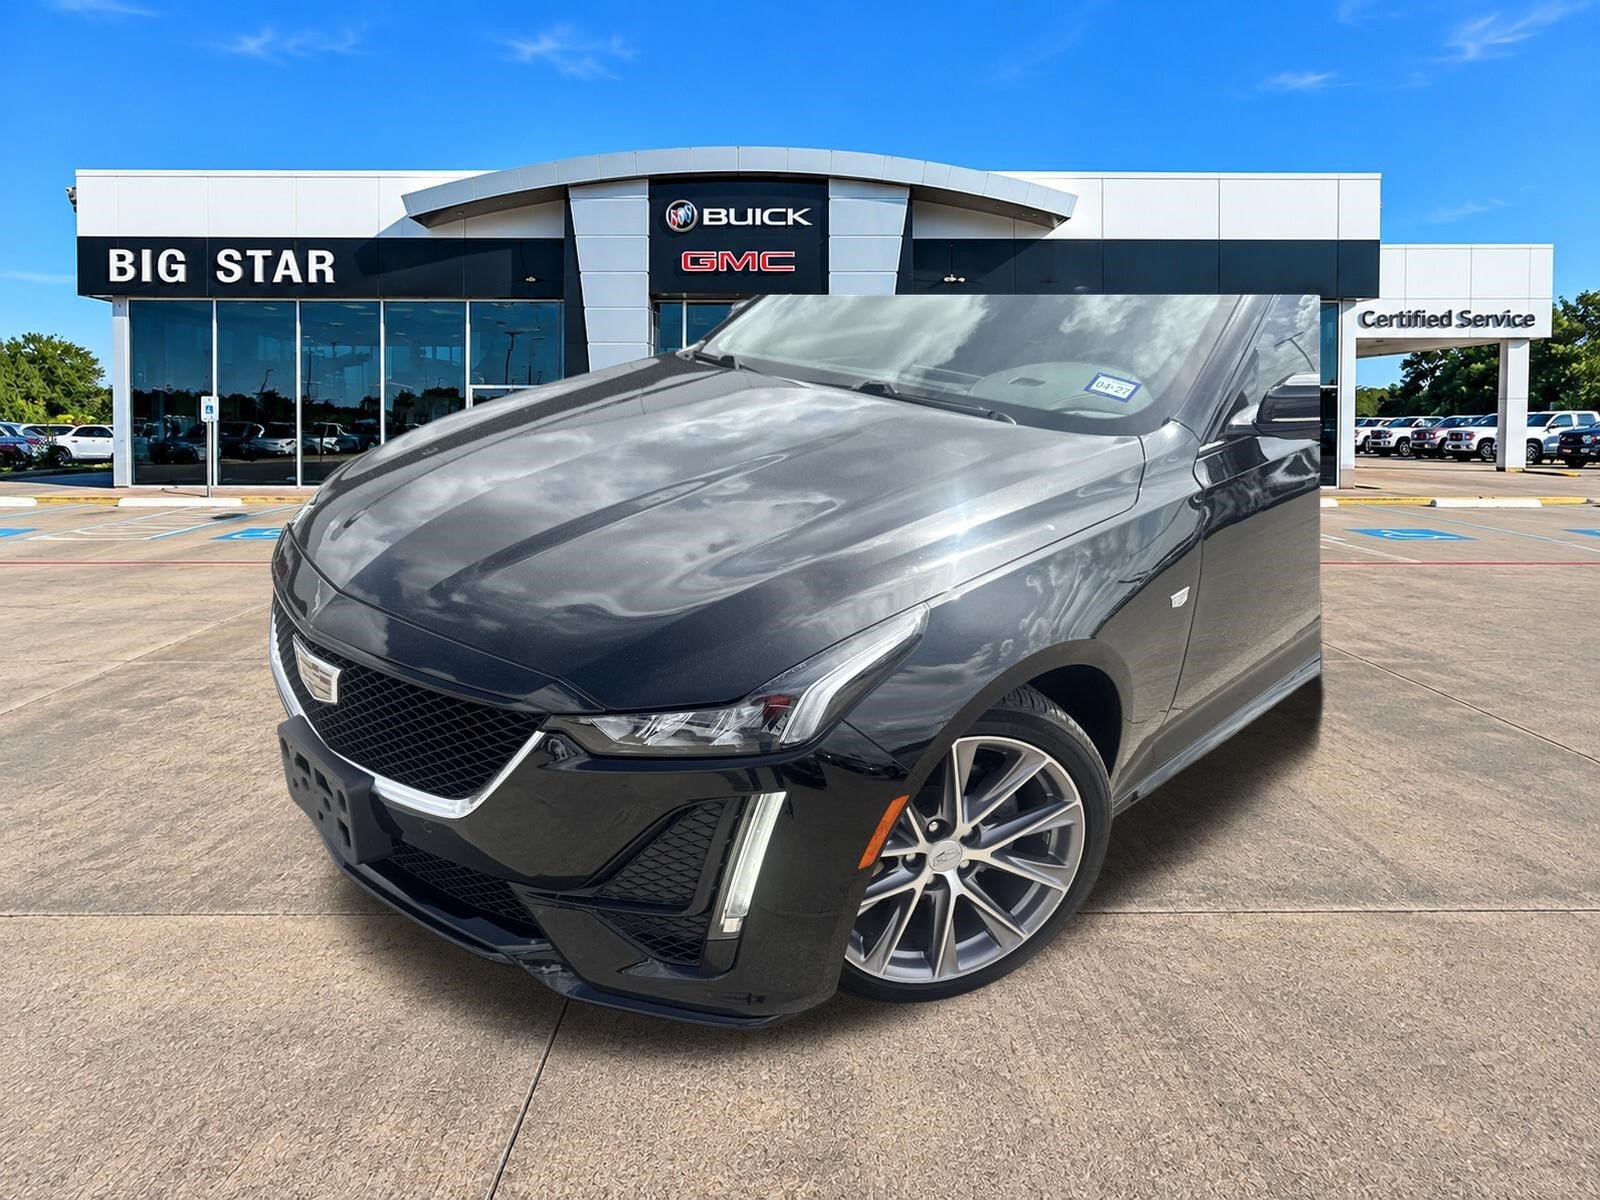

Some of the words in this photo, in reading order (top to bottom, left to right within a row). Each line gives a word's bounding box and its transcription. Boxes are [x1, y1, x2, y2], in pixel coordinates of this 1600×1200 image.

[702, 207, 813, 226] BUICK
[108, 248, 187, 283] BIG
[216, 248, 336, 284] STAR
[681, 250, 796, 272] GMC
[1360, 309, 1453, 328] Certified
[1456, 309, 1536, 328] Service
